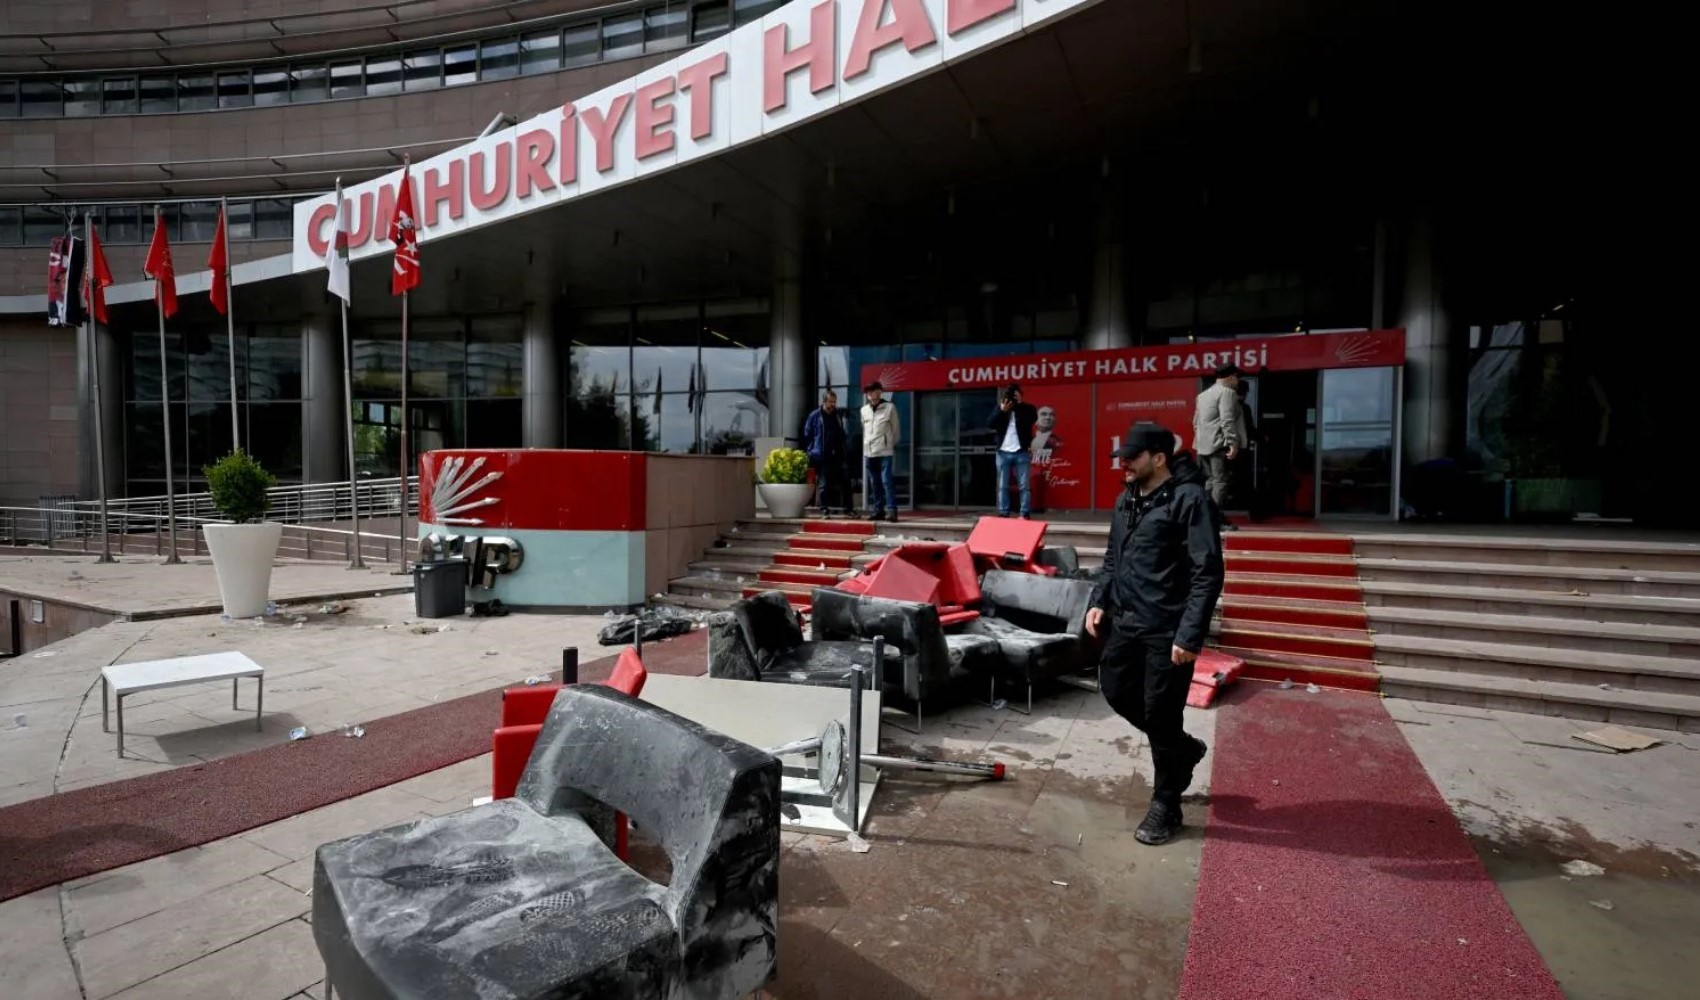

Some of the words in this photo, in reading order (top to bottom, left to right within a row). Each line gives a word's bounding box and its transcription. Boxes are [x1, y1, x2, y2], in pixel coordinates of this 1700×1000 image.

[307, 52, 728, 258] CUMHURİYET
[762, 0, 1017, 114] HA
[948, 358, 1087, 383] CUMHURİYET
[1095, 353, 1158, 376] HALK
[1167, 343, 1267, 371] PARTİSİ
